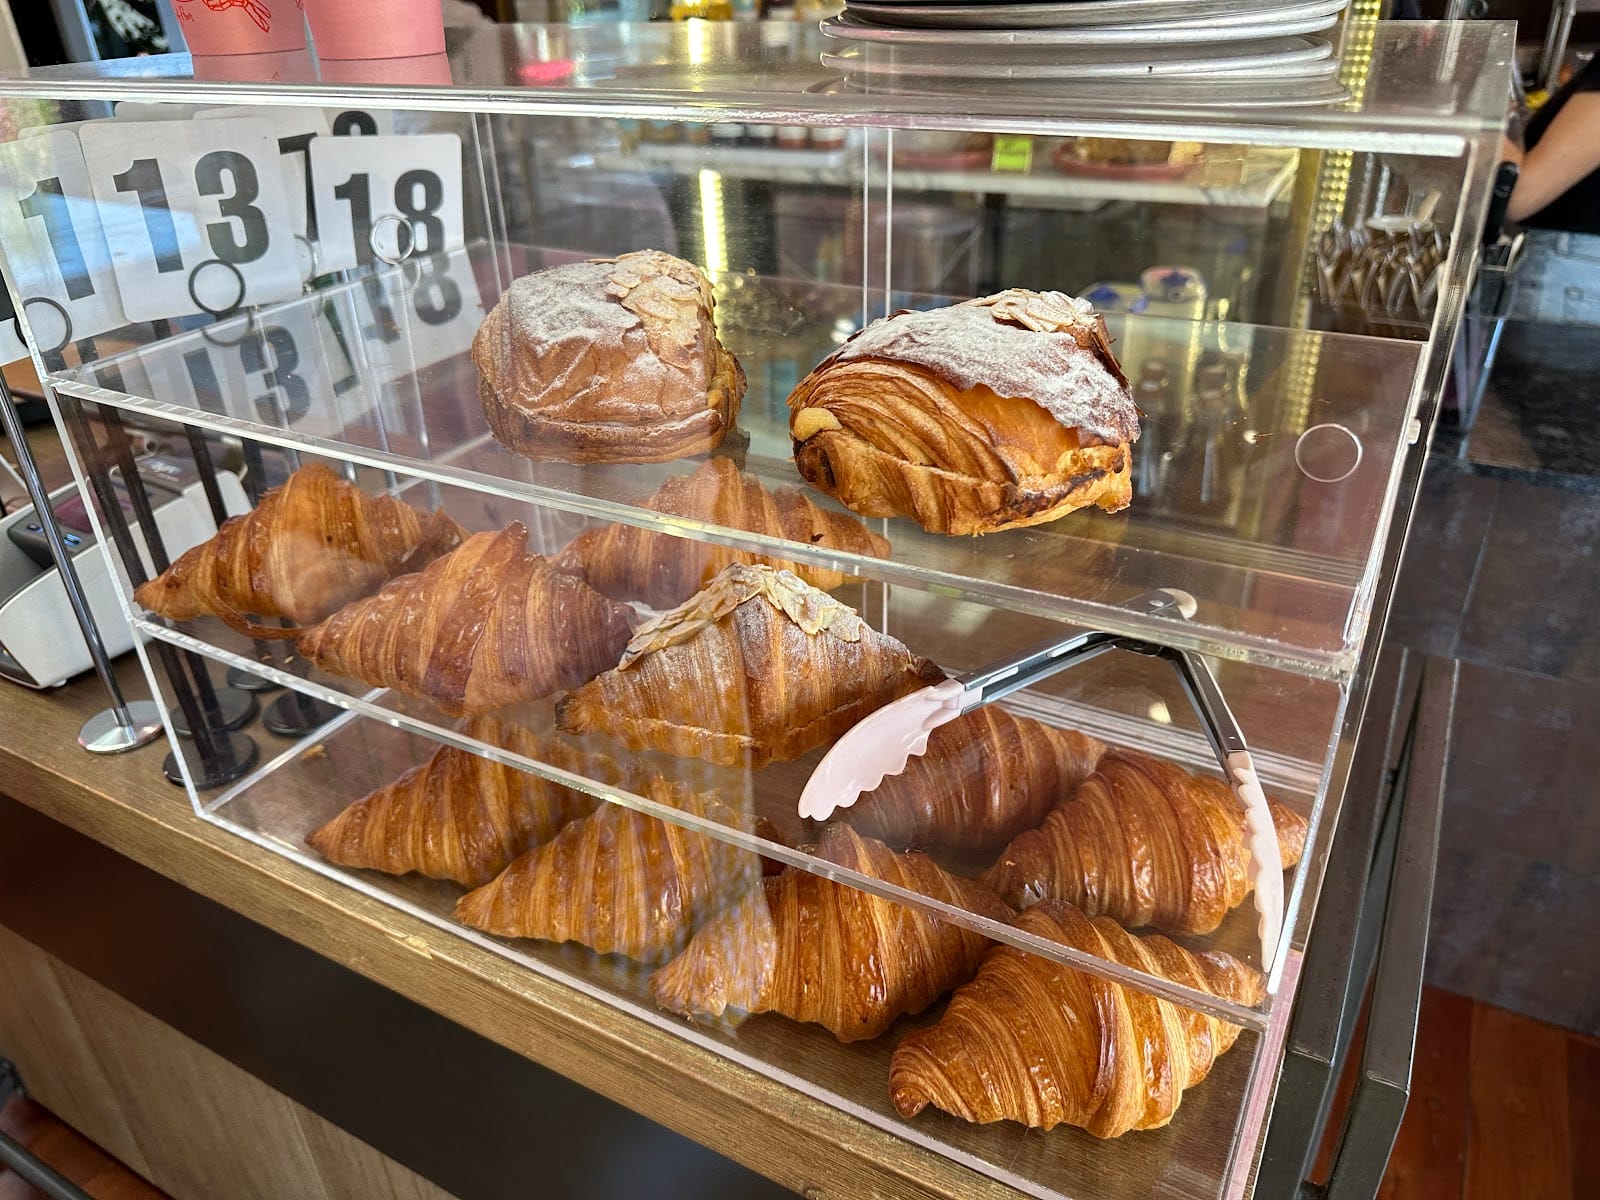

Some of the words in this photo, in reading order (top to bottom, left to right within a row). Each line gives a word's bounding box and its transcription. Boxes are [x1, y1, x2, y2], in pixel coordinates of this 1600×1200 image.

[0, 176, 96, 319] 1
[113, 150, 270, 274] 13
[334, 169, 445, 267] 18
